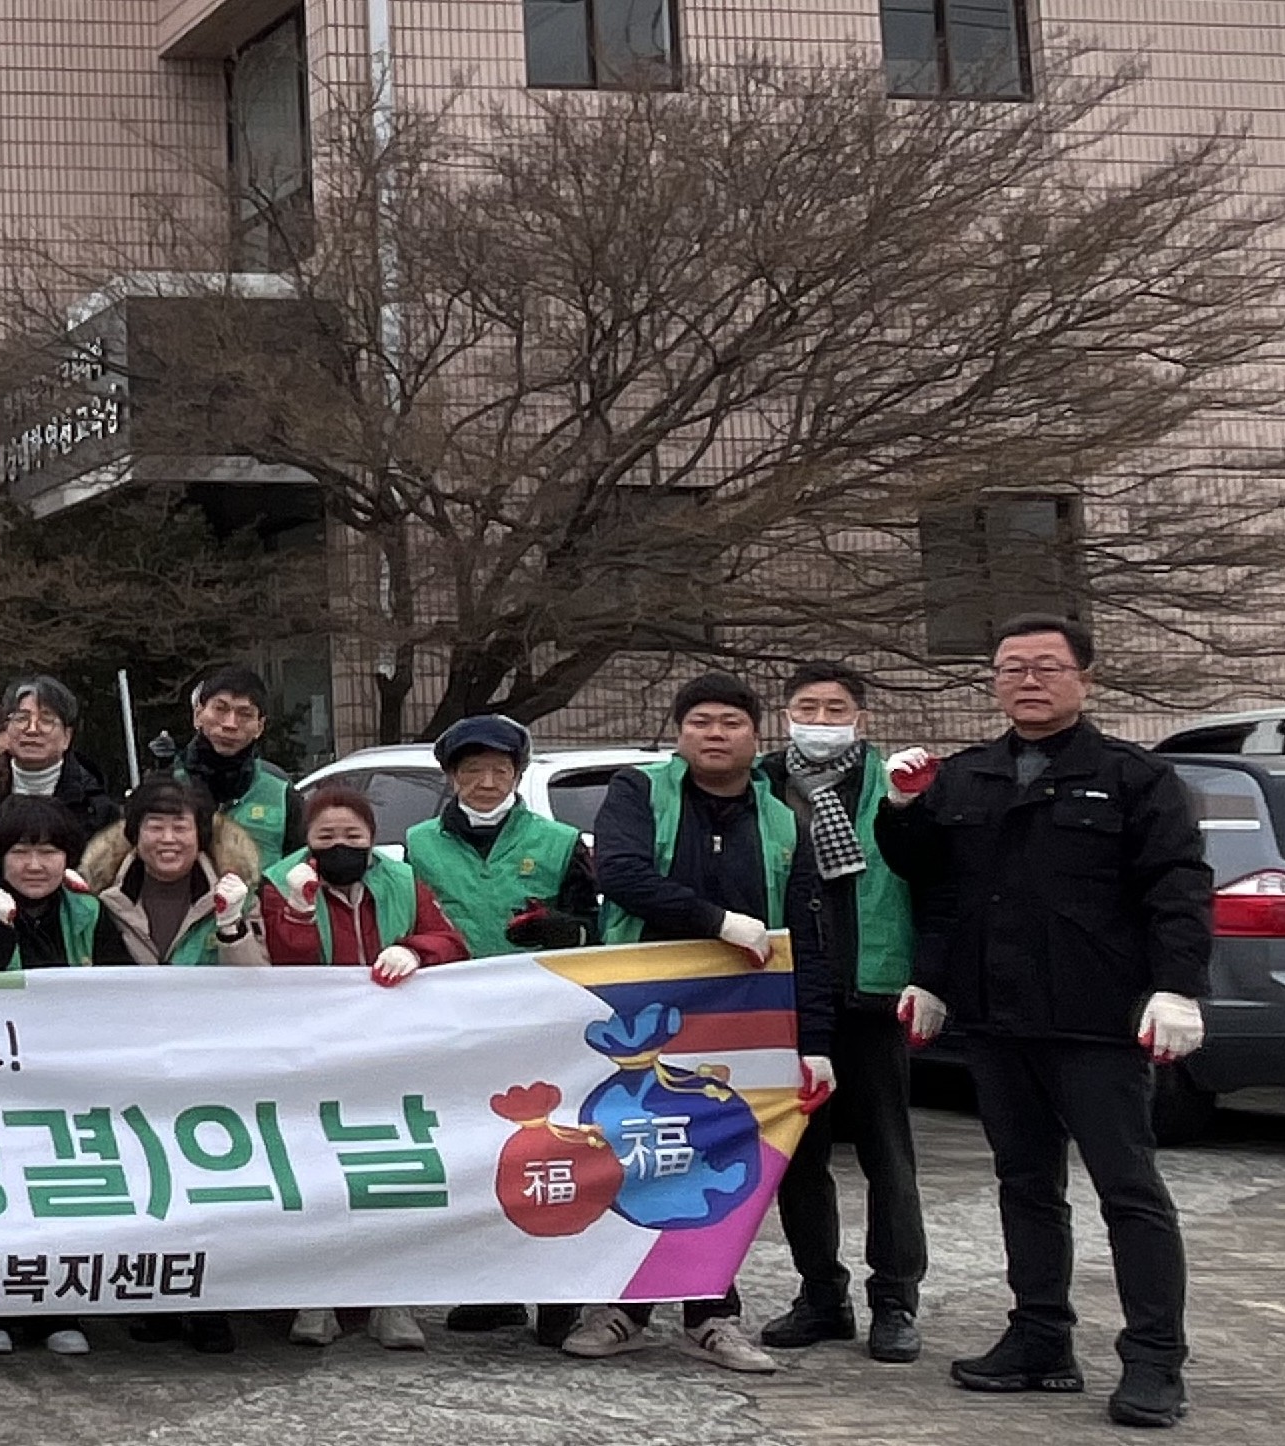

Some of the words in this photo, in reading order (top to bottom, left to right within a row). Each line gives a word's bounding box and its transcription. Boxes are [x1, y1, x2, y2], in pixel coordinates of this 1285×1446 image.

[320, 1095, 448, 1210] 날
[620, 1115, 694, 1180] 福
[523, 1159, 577, 1206] 福
